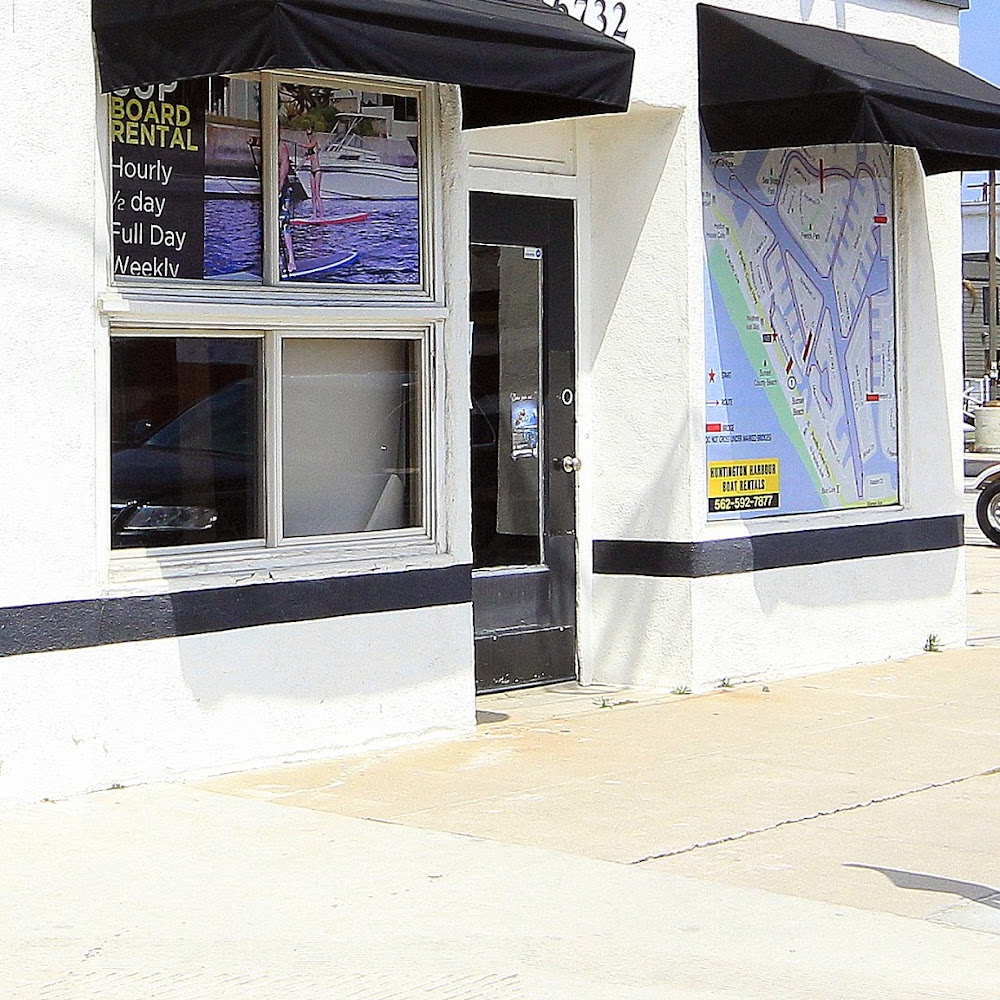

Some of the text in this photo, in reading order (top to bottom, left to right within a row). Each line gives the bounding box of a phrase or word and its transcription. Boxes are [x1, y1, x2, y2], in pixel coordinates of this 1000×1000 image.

[111, 96, 191, 127] BOARD
[111, 120, 199, 152] RENTAL
[112, 156, 172, 185] Hourly
[131, 190, 166, 217] day
[150, 224, 186, 251] Day
[710, 463, 776, 478] HUNTINGTON HARBOUR
[723, 479, 765, 492] BOAT RENTALS
[714, 495, 773, 511] 562-592-7877
